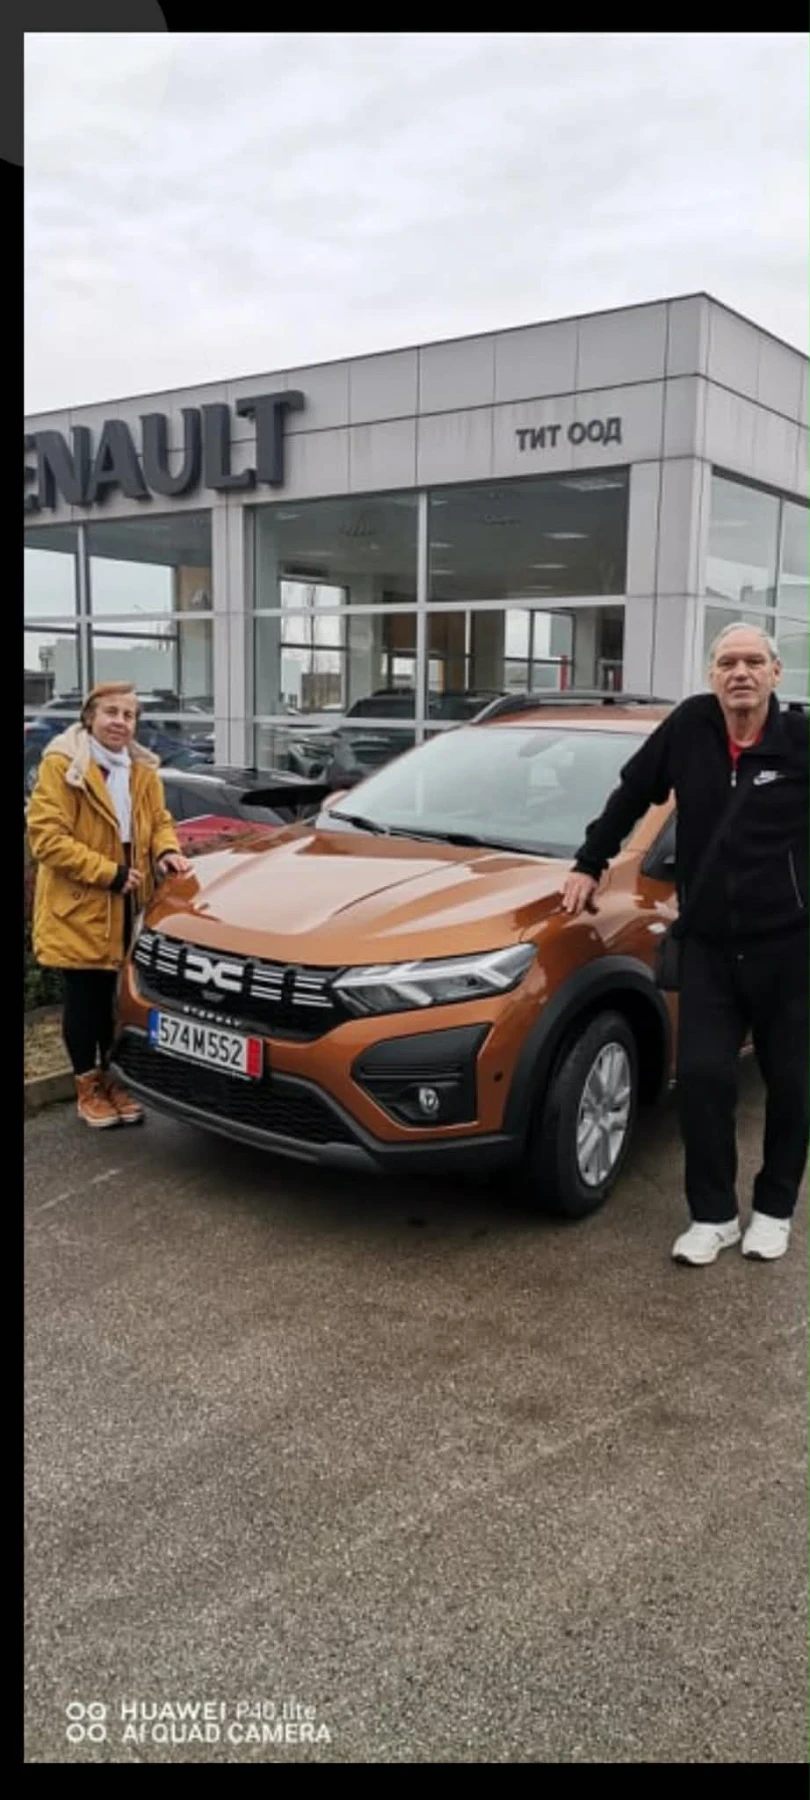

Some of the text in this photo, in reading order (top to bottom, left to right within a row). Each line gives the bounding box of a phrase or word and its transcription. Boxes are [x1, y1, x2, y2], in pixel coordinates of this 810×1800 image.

[515, 416, 622, 451] ТИТ ООД
[160, 1017, 243, 1066] 574M552
